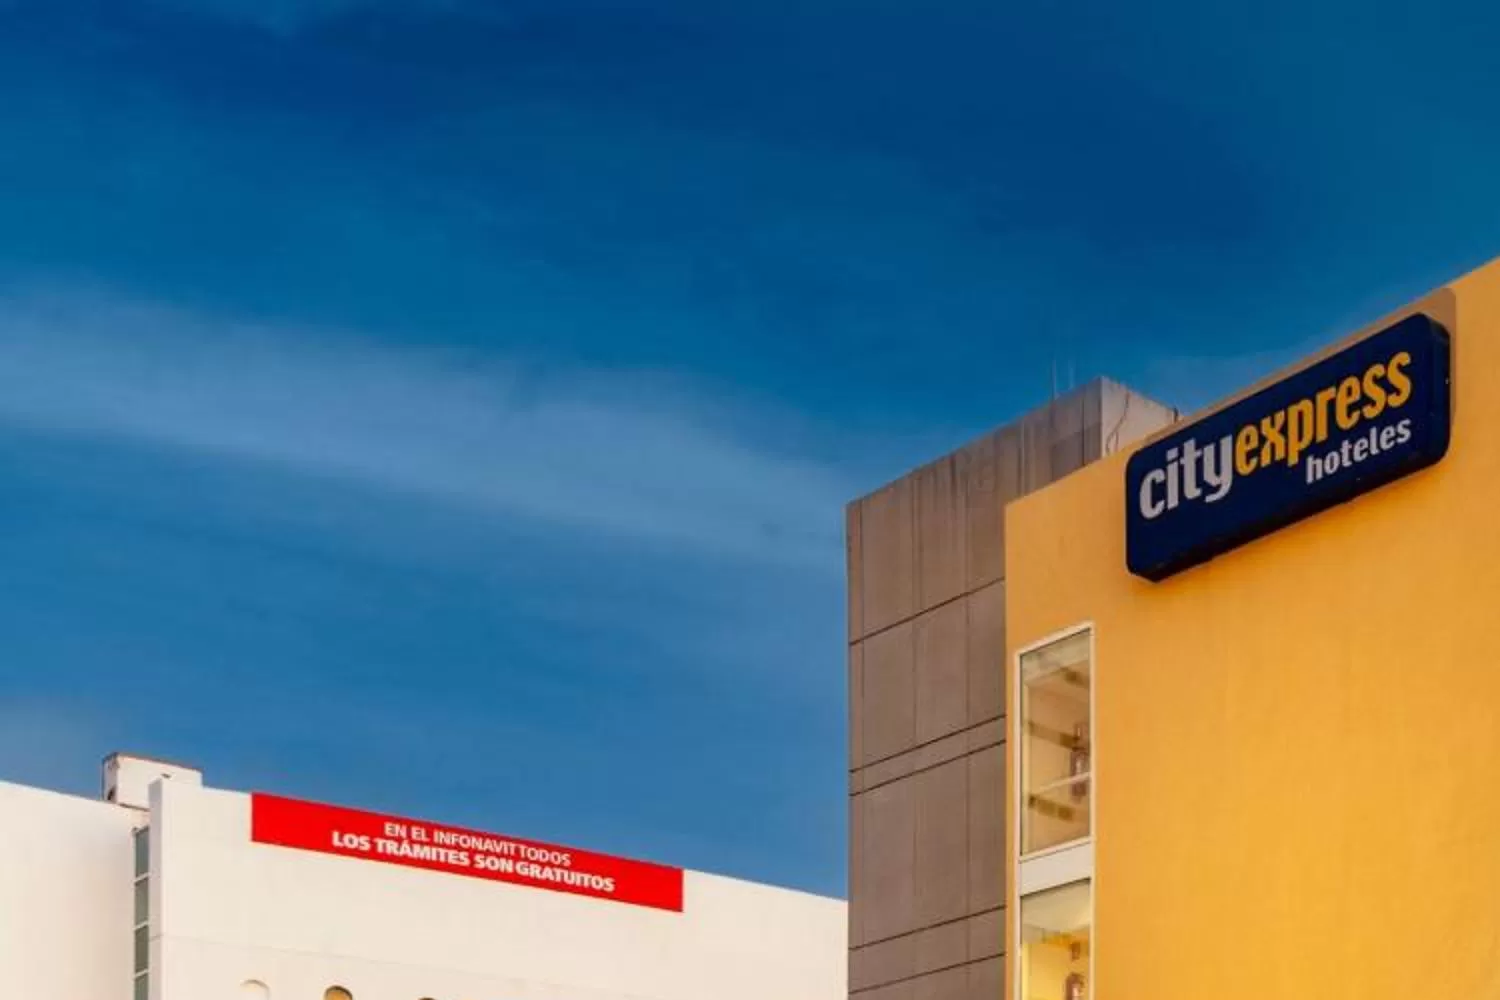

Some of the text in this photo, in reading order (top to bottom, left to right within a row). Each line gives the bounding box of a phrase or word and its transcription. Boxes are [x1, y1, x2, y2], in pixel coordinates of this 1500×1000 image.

[1139, 351, 1413, 519] cityexpress
[1306, 419, 1412, 484] hoteles
[332, 831, 615, 892] LOS TRÁMITES SON GRATUITOS
[384, 822, 571, 867] EN EL INFONAVIT TODOS
